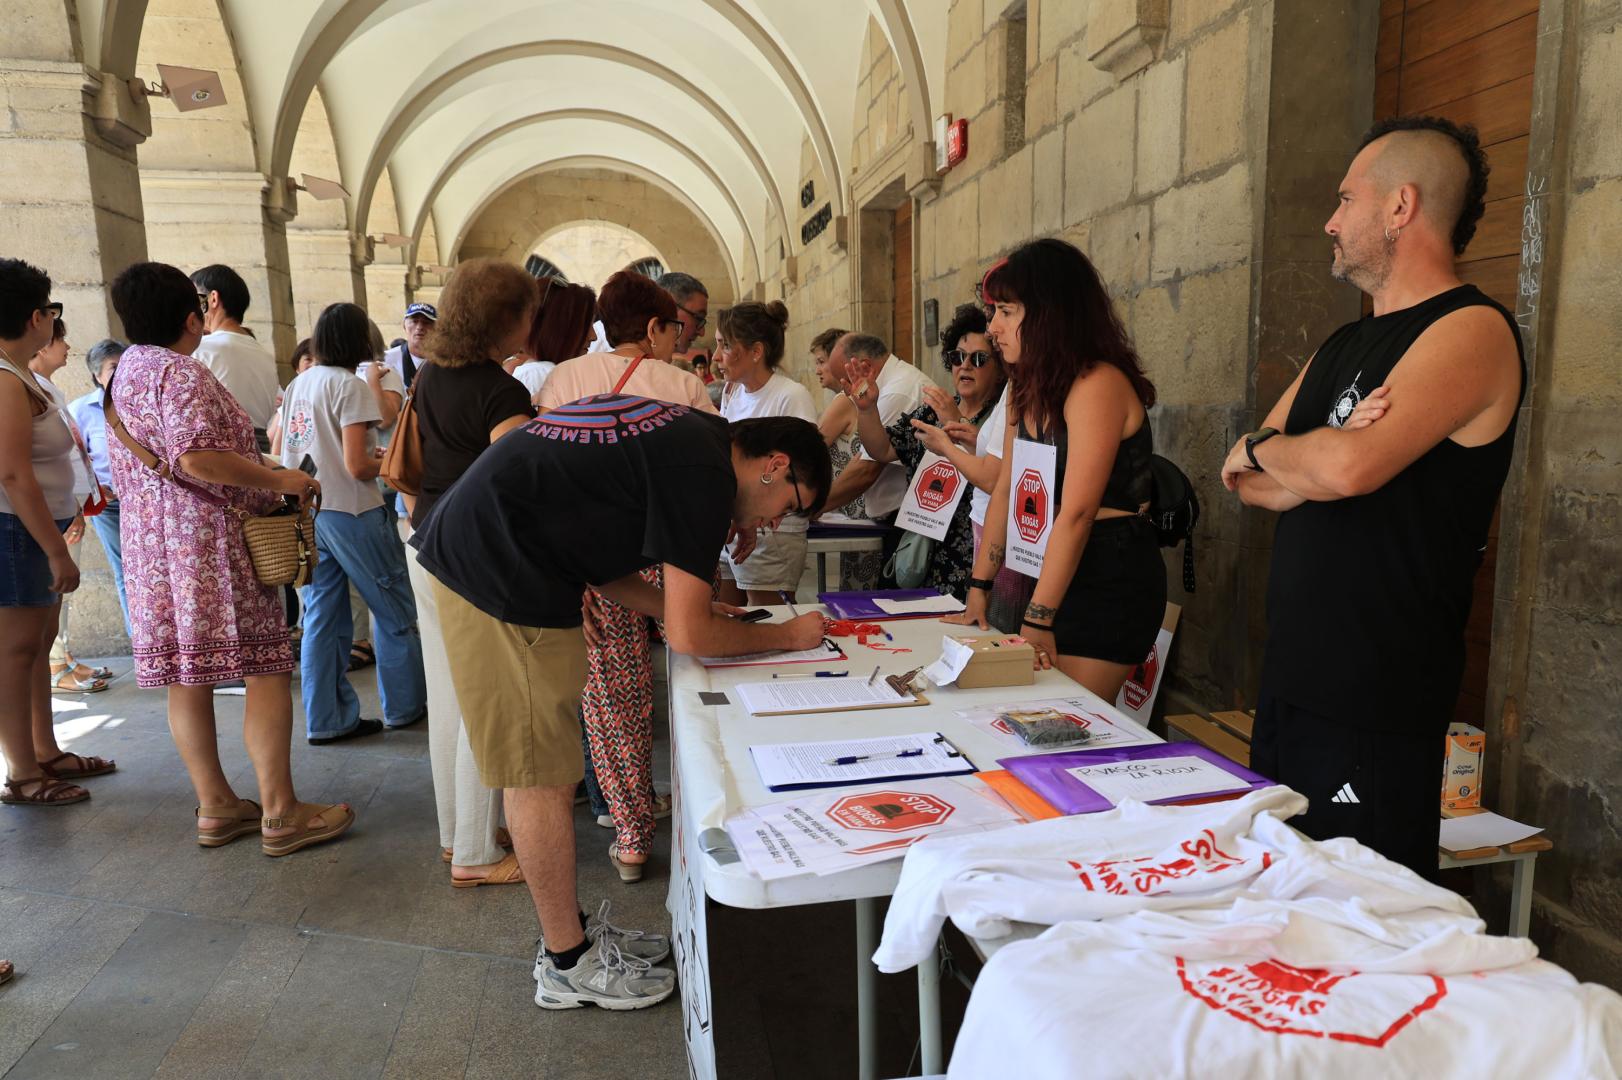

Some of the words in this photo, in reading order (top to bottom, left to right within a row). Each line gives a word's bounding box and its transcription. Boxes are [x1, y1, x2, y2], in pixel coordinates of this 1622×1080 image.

[526, 423, 619, 444] ELEMENT
[932, 466, 954, 478] STOP
[1023, 478, 1040, 494] STOP
[1096, 764, 1147, 775] VASCO
[1129, 772, 1150, 780] LA
[1152, 766, 1201, 775] RIOJA
[1452, 768, 1475, 776] Original
[900, 796, 941, 814] STOP
